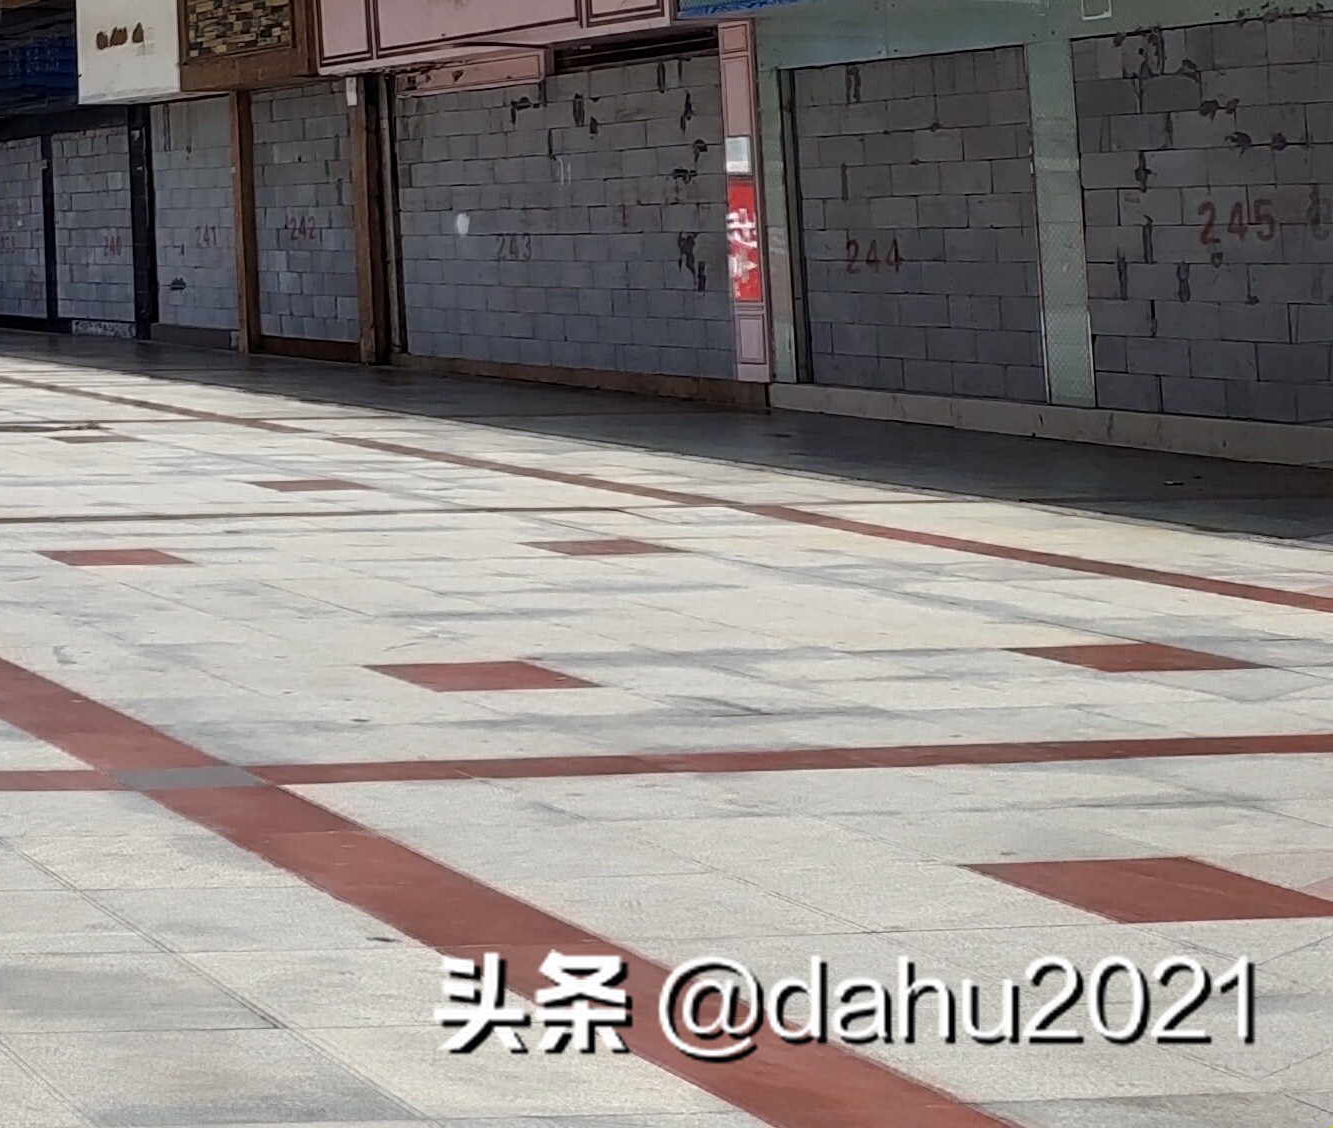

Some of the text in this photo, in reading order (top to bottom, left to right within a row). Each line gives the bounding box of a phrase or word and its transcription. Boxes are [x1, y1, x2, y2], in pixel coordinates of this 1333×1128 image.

[195, 225, 218, 247] 241
[290, 216, 316, 241] 242
[1198, 199, 1277, 245] 245
[495, 233, 531, 261] 243
[846, 238, 903, 273] 244
